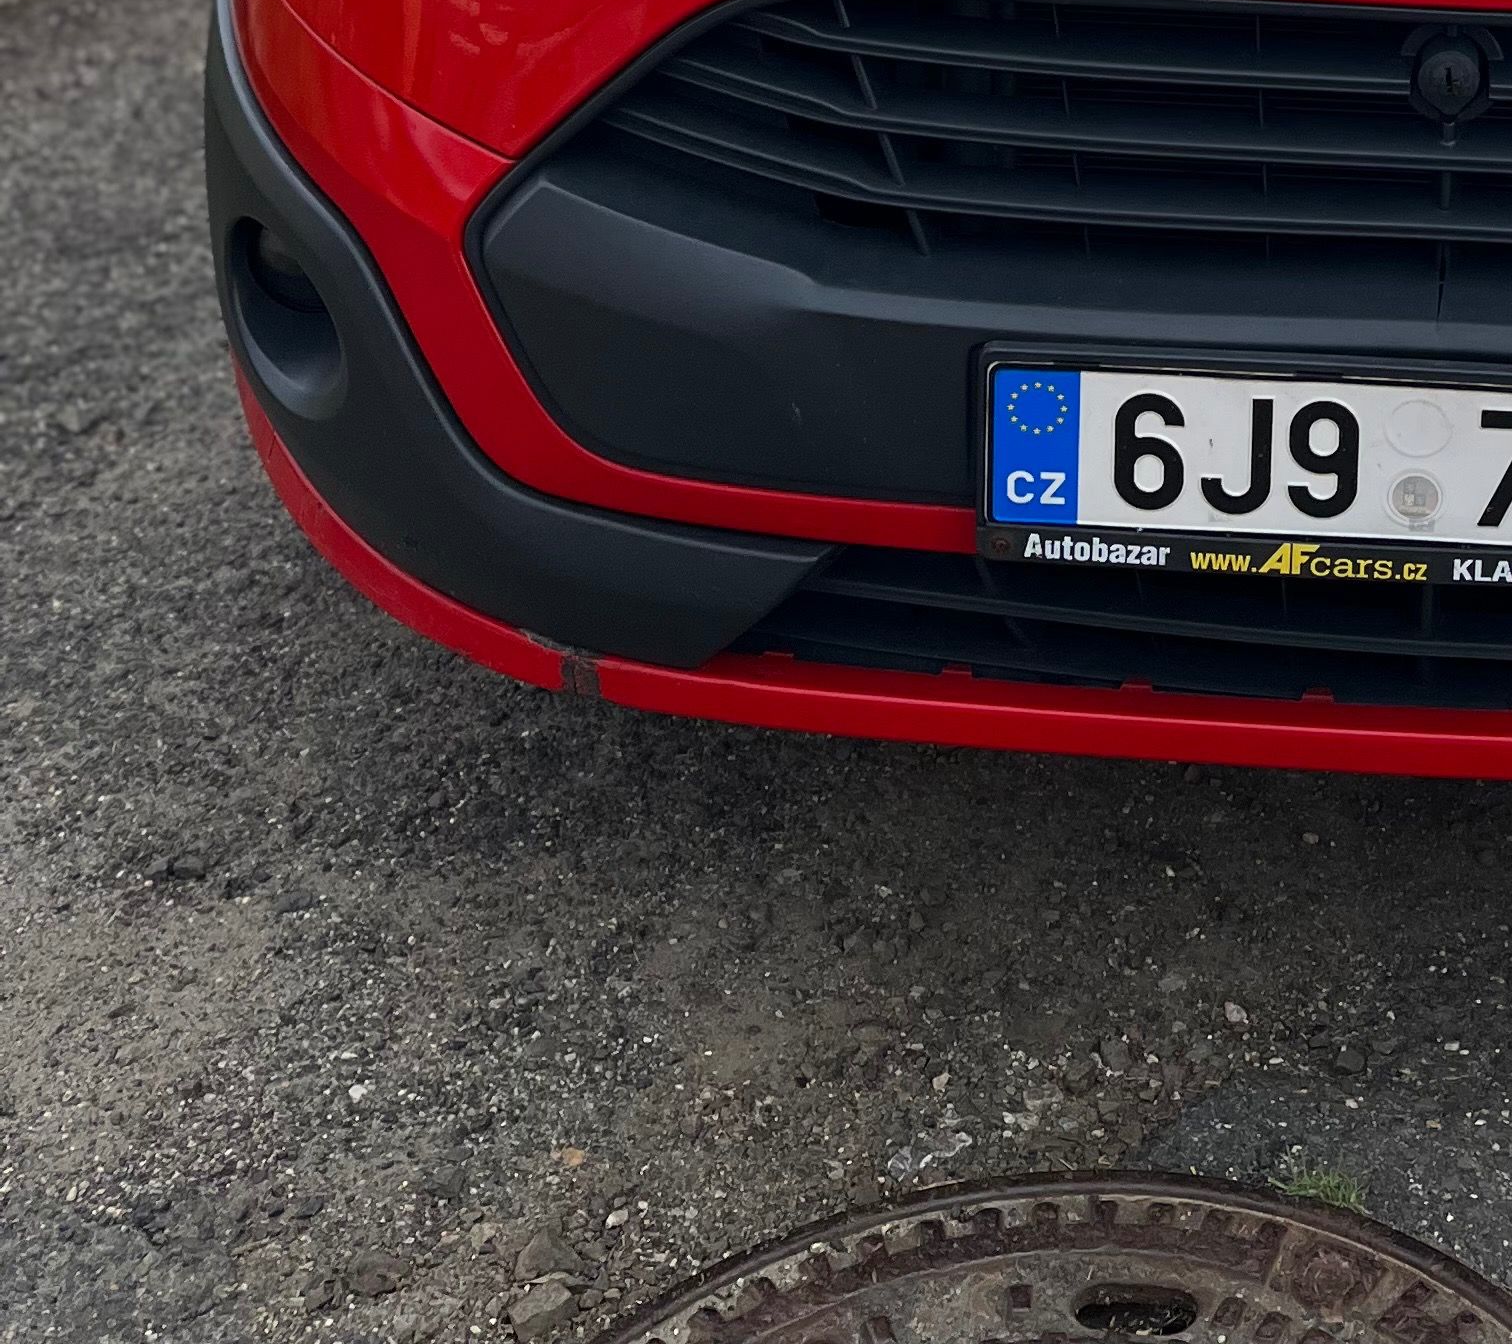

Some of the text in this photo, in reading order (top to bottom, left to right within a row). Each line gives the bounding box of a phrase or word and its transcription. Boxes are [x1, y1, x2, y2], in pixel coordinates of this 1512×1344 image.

[1113, 392, 1360, 518] 6J9
[1006, 469, 1067, 506] CZ
[1023, 532, 1171, 567] Autobazar
[1190, 542, 1428, 582] www.AFcars.cz
